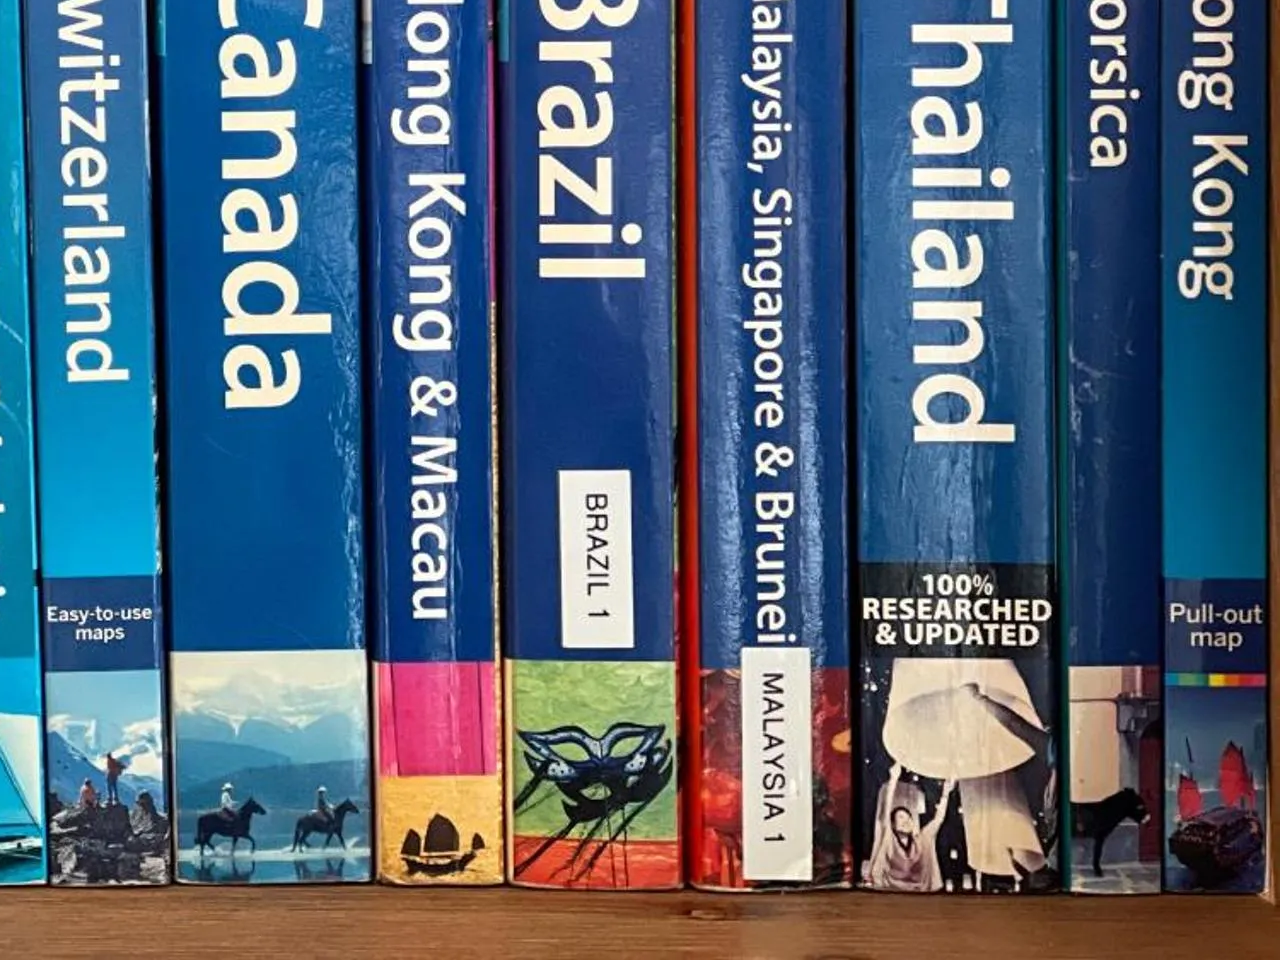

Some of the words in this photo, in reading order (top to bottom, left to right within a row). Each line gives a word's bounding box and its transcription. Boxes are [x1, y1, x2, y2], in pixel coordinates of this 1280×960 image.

[1178, 135, 1248, 300] Kong
[392, 173, 466, 352] Kong
[742, 188, 793, 429] Singapore
[409, 375, 458, 417] &
[754, 442, 795, 478] &
[411, 435, 458, 619] Macau
[585, 493, 609, 596] BRAZIL
[754, 491, 797, 644] Brunei
[917, 573, 994, 596] 100%
[47, 606, 153, 626] Easy-to-use
[863, 597, 1052, 622] RESEARCHED
[1170, 603, 1261, 623] Pull-out
[75, 621, 125, 643] maps
[875, 623, 897, 645] &
[903, 623, 1040, 647] UPDATED
[1190, 631, 1242, 651] map
[762, 673, 786, 821] MALAYSIA
[764, 833, 785, 842] 1
